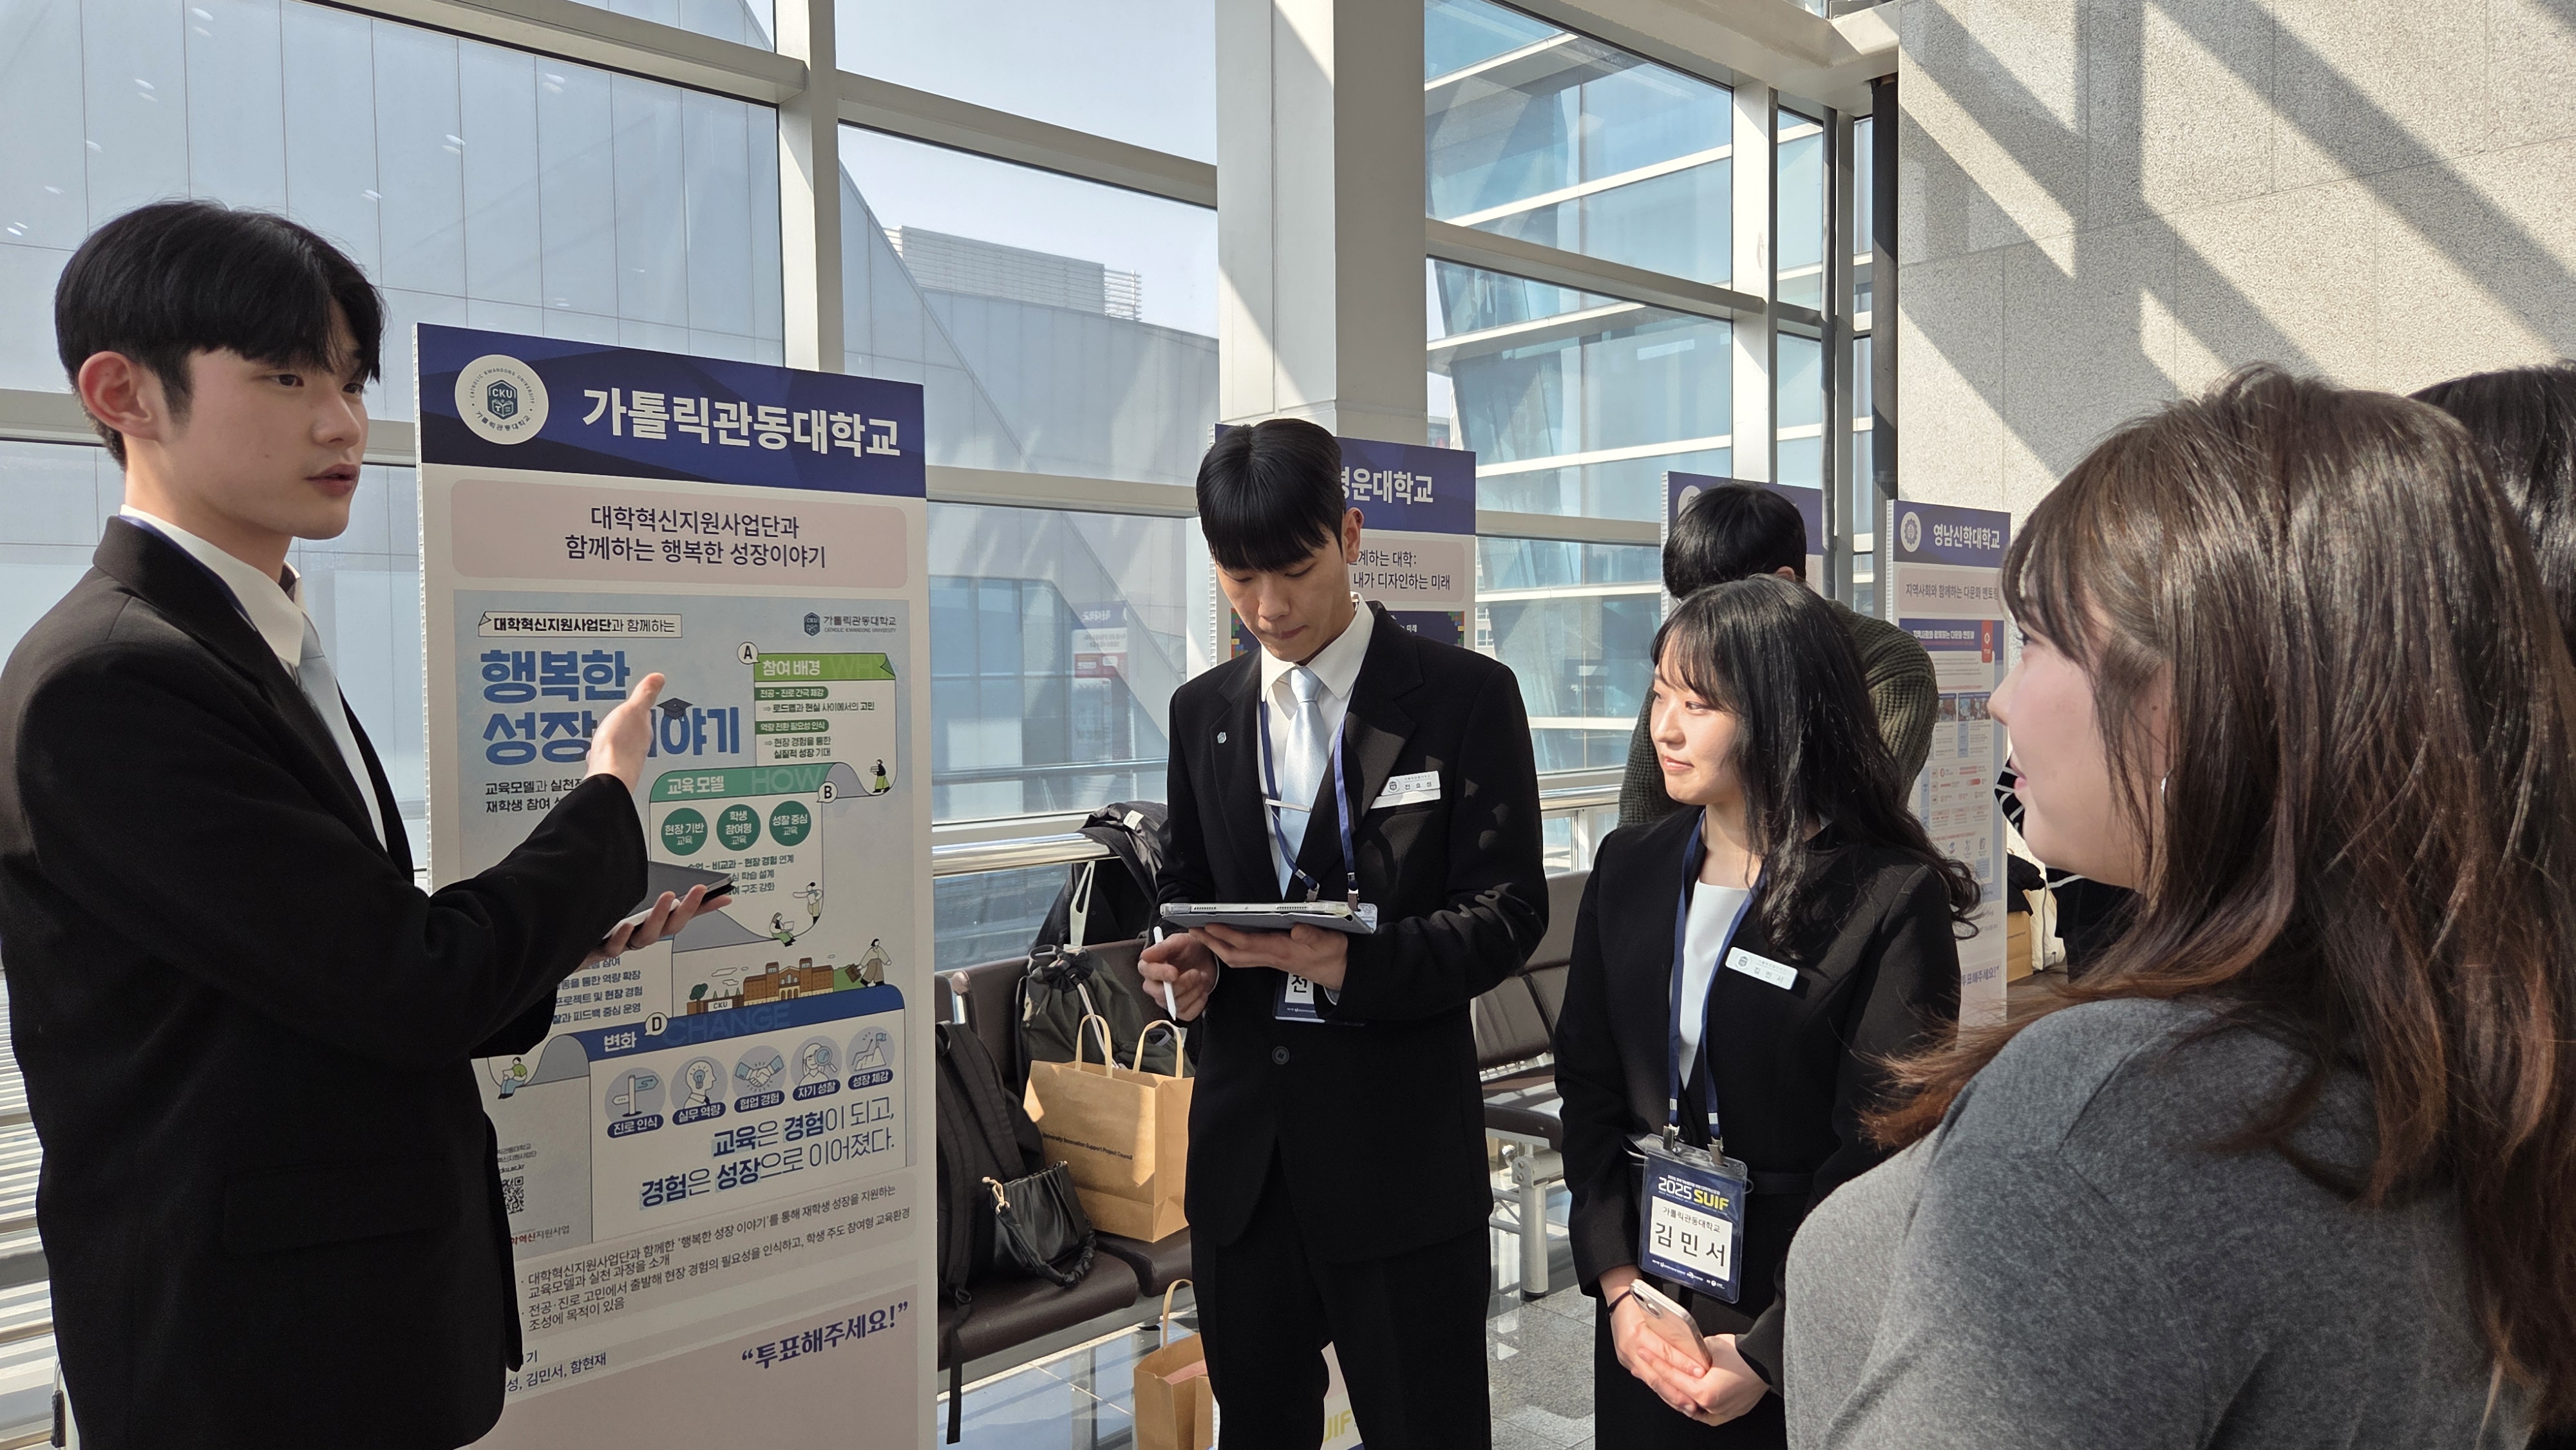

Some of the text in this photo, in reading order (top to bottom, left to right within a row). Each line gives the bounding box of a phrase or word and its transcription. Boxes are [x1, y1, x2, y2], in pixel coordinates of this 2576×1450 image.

[492, 388, 513, 399] CKU
[582, 388, 900, 457] 가톨릭관동대학교
[591, 505, 799, 539] 대학혁신지원사업단과
[1933, 523, 2000, 550] 영남신학대학교
[565, 533, 826, 569] 함께하는 행복한 성장이야기
[1349, 549, 1417, 568] 계하는 대학:
[1354, 572, 1450, 590] 내가 디자인하는 미래
[1906, 583, 1937, 598] 지역사회와
[1939, 585, 1963, 599] 함께하는
[1964, 586, 1981, 599] 다문화
[494, 617, 676, 633] 대학혁신지원사업단과 함께하는
[824, 616, 896, 626] 가톨릭관동대학교
[743, 645, 753, 660] A
[762, 660, 820, 676] 참여 배경
[480, 650, 630, 704] 행복한
[781, 688, 795, 697] 진로
[773, 702, 875, 713] 로드맵과 현실 사이에서의 고민
[811, 721, 825, 730] 인식
[774, 736, 831, 748] 현장 경험을 통한
[774, 748, 831, 759] 실질적 성장 기대
[485, 779, 548, 795] 교육모델과
[667, 775, 725, 795] 교육 모델
[824, 785, 832, 799] B
[486, 798, 523, 814] 재학생
[527, 797, 551, 811] 참여
[730, 811, 748, 822] 학생
[773, 813, 808, 826] 성찰 중심
[665, 822, 705, 836] 현장 기반
[725, 823, 752, 835] 참여형
[783, 826, 798, 836] 교육
[676, 836, 693, 845] 교육
[730, 835, 747, 845] 교육
[712, 860, 737, 870] 비교과
[744, 858, 761, 868] 현장
[762, 856, 777, 865] 경험
[779, 854, 794, 865] 연계
[741, 869, 775, 881] 학습 설계
[741, 882, 775, 894] 구조 강화
[582, 970, 641, 987] 통한 역량 확장
[1291, 974, 1307, 993] 전
[556, 986, 643, 1007] 프로젝트 및 현장 경험
[573, 1003, 641, 1022] 피드백 중심 운영
[713, 1001, 728, 1010] CKU
[652, 1016, 662, 1031] D
[604, 1031, 637, 1053] 변화
[853, 1071, 889, 1088] 성장 체감
[798, 1082, 836, 1098] 자기 성찰
[740, 1093, 780, 1110] 협업 경험
[678, 1104, 721, 1123] 실무 역량
[614, 1116, 658, 1136] 진로 인식
[713, 1096, 895, 1157] 교육은 경험이 되고,
[1063, 1137, 1133, 1160] Innovation Support Project Council
[642, 1127, 895, 1207] 경험은 성장으로 이어졌다.
[1658, 1176, 1692, 1200] 2025
[1694, 1189, 1729, 1210] SUIF
[1663, 1206, 1721, 1233] 가톨릭관동대학교
[528, 1248, 641, 1285] 대학혁신지원사업단과
[643, 1239, 675, 1257] 함께한
[714, 1225, 734, 1239] 성장
[781, 1208, 800, 1223] 통해
[802, 1200, 830, 1217] 재학생
[832, 1192, 859, 1210] 성장을
[861, 1185, 896, 1202] 지원하는
[583, 1281, 627, 1304] 고민에서
[630, 1273, 662, 1292] 출발해
[665, 1266, 685, 1283] 현장
[688, 1257, 719, 1276] 경험의
[721, 1247, 761, 1268] 필요성을
[762, 1237, 804, 1257] 인식하고,
[806, 1229, 825, 1245] 학생
[827, 1225, 846, 1239] 주도
[847, 1216, 874, 1234] 참여형
[875, 1207, 910, 1225] 교육환경
[528, 1253, 670, 1299] 교육모델과 실천 과정을 소개
[528, 1296, 625, 1332] 조성에 목적이 있음
[741, 1301, 909, 1369] “투표해주세요!”
[526, 1351, 607, 1387] 김민서, 함현재
